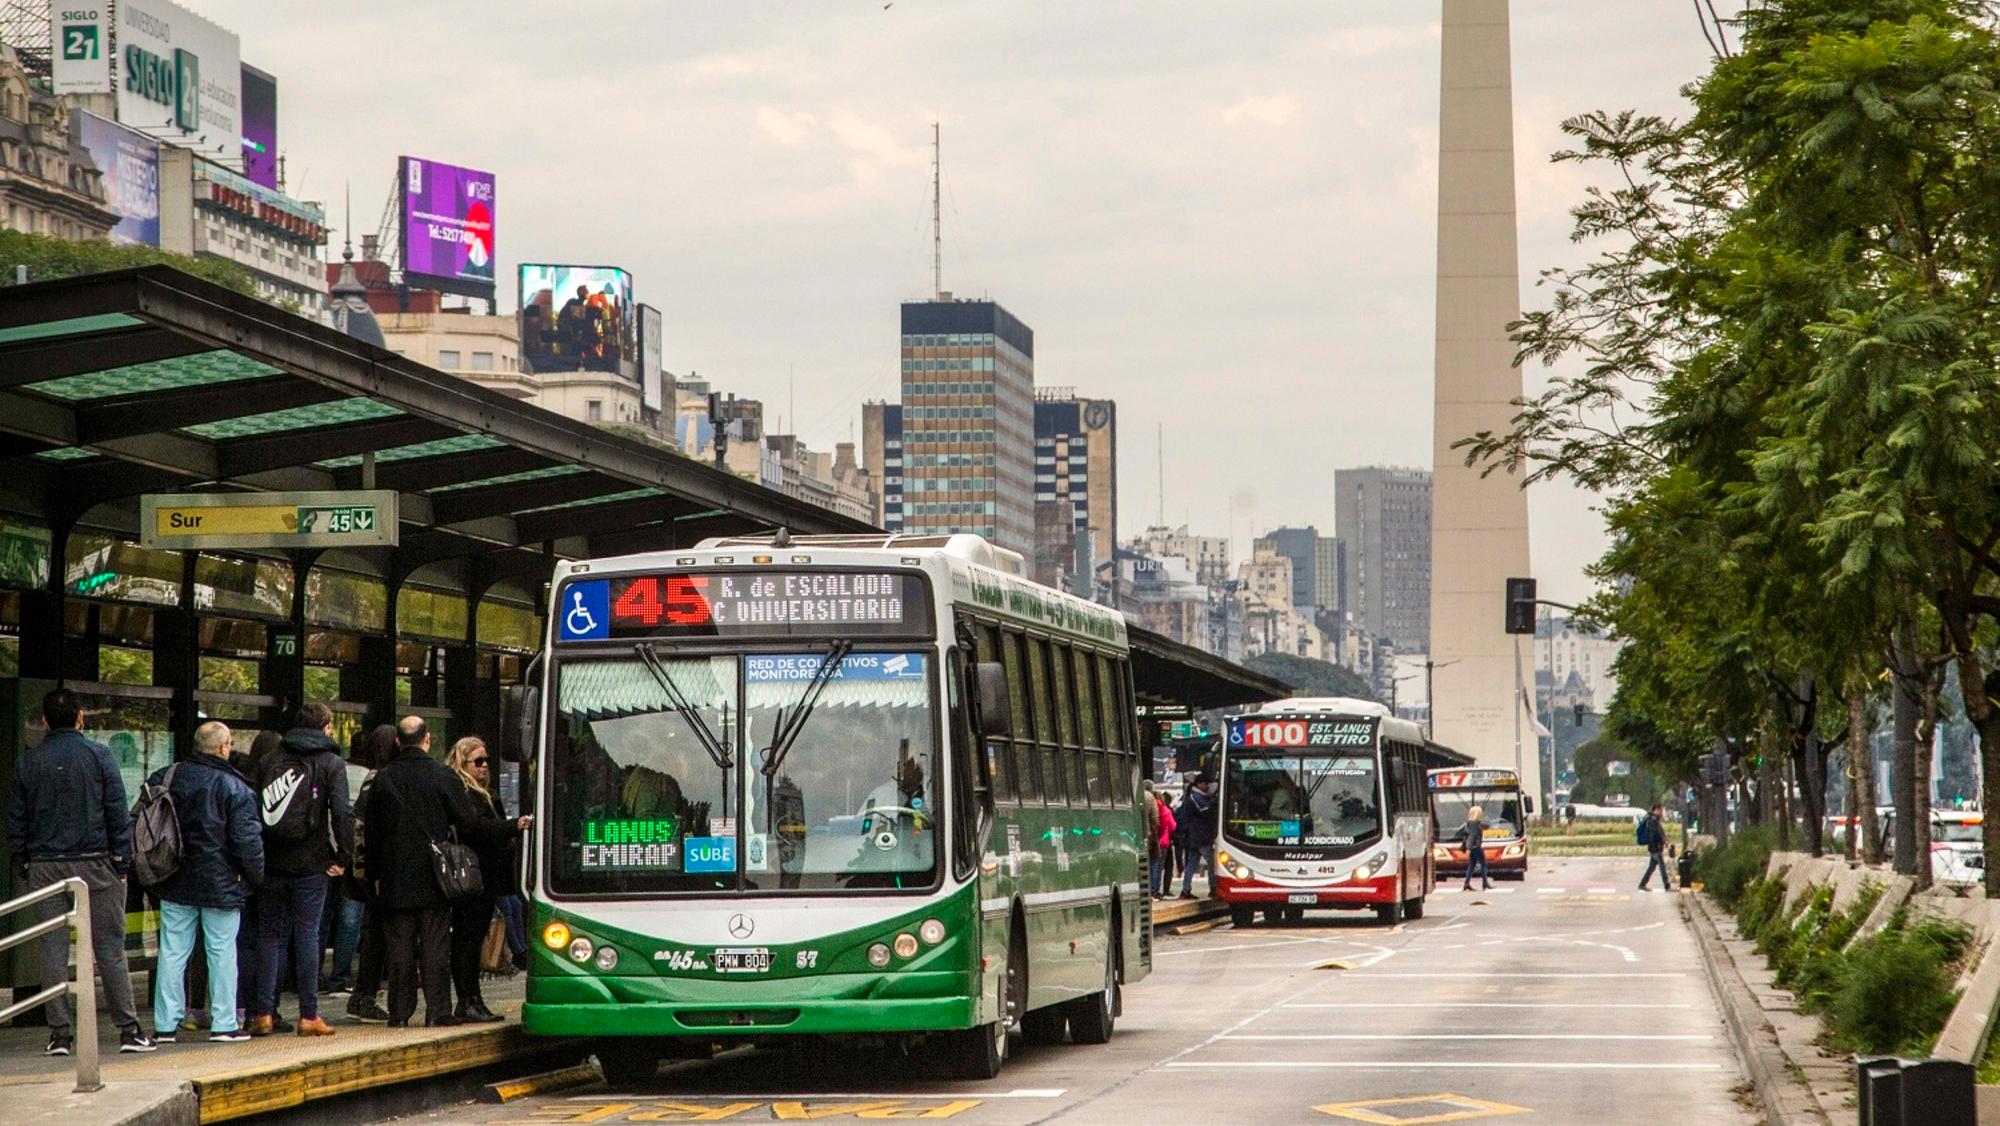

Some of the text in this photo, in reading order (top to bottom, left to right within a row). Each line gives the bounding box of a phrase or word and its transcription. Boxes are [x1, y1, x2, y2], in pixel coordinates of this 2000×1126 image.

[62, 10, 98, 21] SIGLO
[124, 4, 170, 43] UNIVERSIDAD
[67, 31, 94, 60] 21
[126, 44, 174, 106] SIGLO
[170, 512, 350, 532] Sur 45
[615, 574, 893, 624] 45 R. de ESCALADA
[713, 598, 901, 622] C UNIVERSITARIA
[275, 640, 295, 655] 70
[748, 659, 777, 670] RED
[778, 658, 794, 669] DE
[1246, 723, 1372, 745] 100 EST. LANUS
[1310, 734, 1371, 745] RETIRO
[262, 768, 296, 810] NIKE
[588, 821, 671, 843] LANUS
[582, 844, 676, 866] EMIRAP
[690, 845, 731, 862] SUBE
[669, 951, 695, 970] 45
[718, 954, 738, 968] PMW
[745, 954, 766, 968] 804
[797, 951, 818, 968] 57
